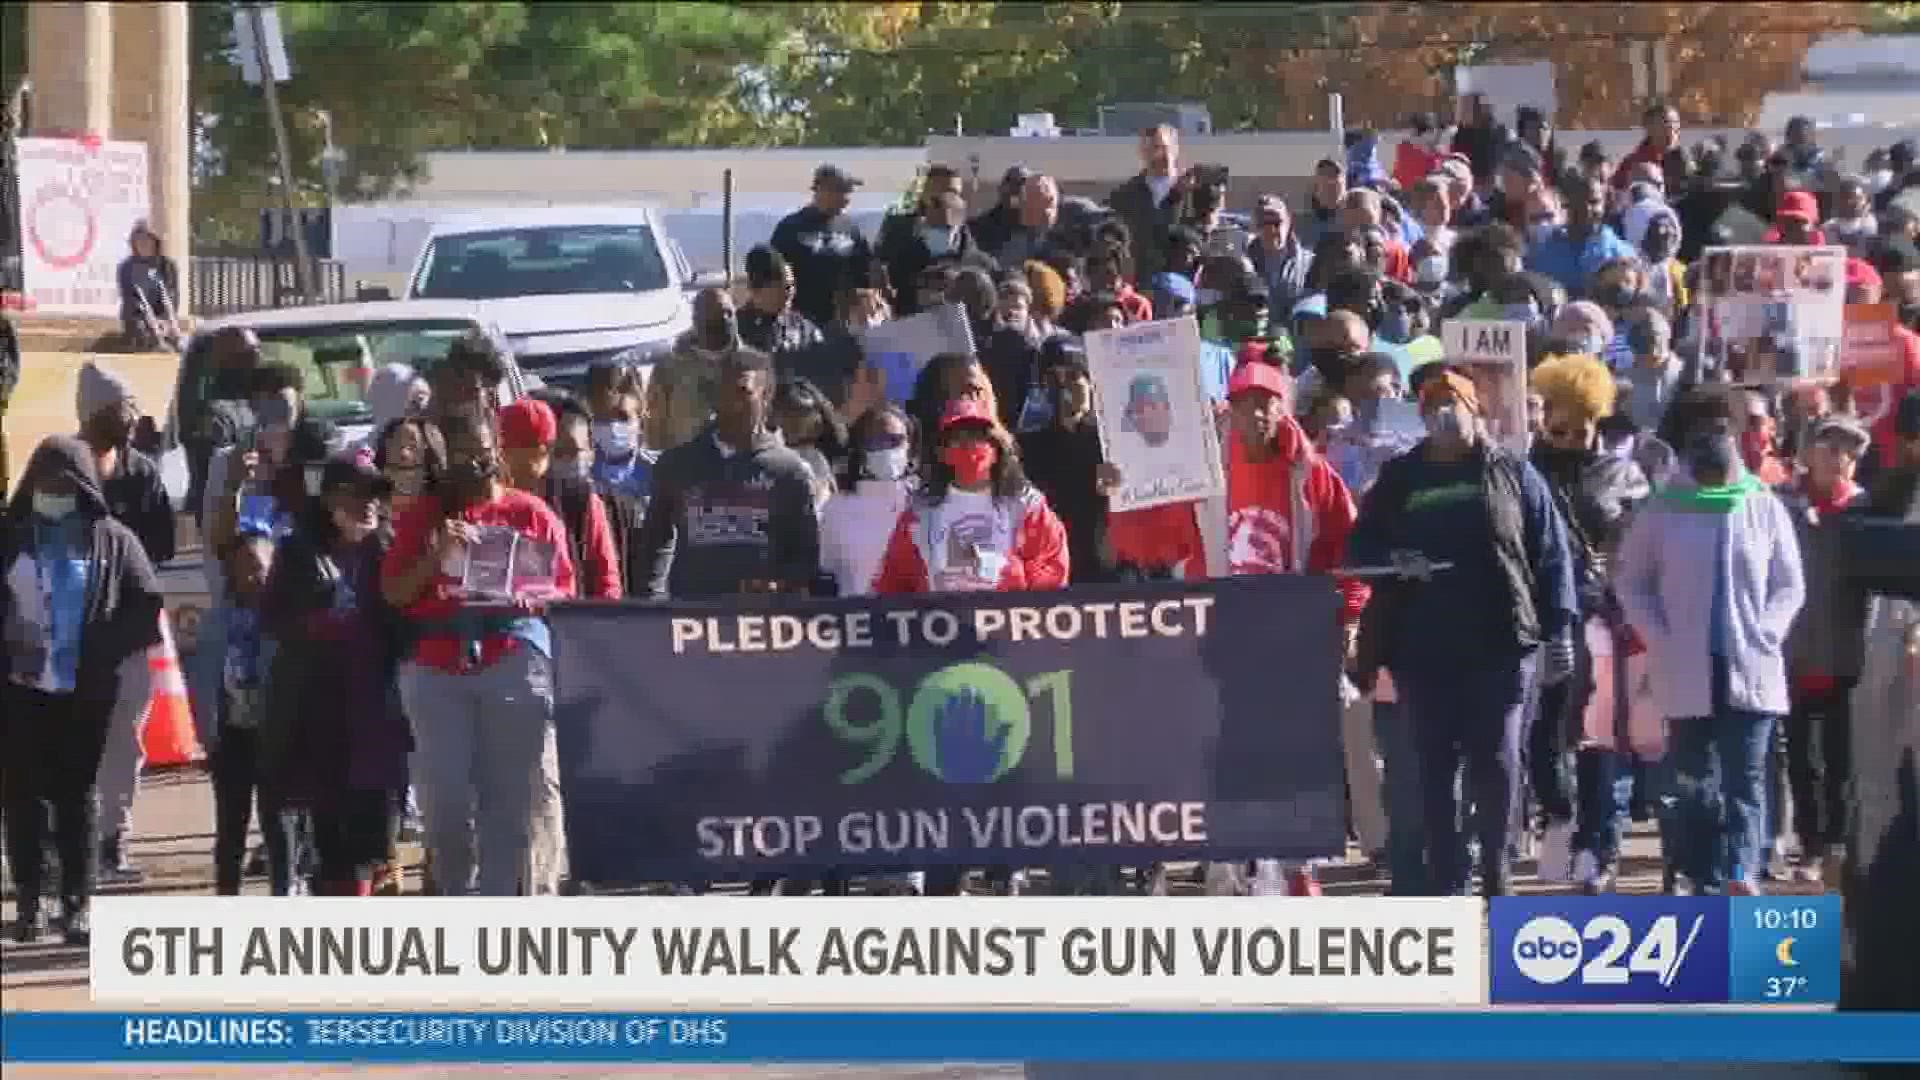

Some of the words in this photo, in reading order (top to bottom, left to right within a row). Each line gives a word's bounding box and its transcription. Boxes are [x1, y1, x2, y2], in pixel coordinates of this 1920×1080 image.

[1462, 325, 1470, 352] I
[1475, 326, 1511, 355] AM
[671, 612, 874, 654] PLEDGE
[885, 610, 959, 645] TO
[974, 598, 1215, 642] PROTECT
[696, 815, 822, 858] STOP
[838, 808, 948, 852] GUN
[961, 801, 1208, 848] VIOLENCE
